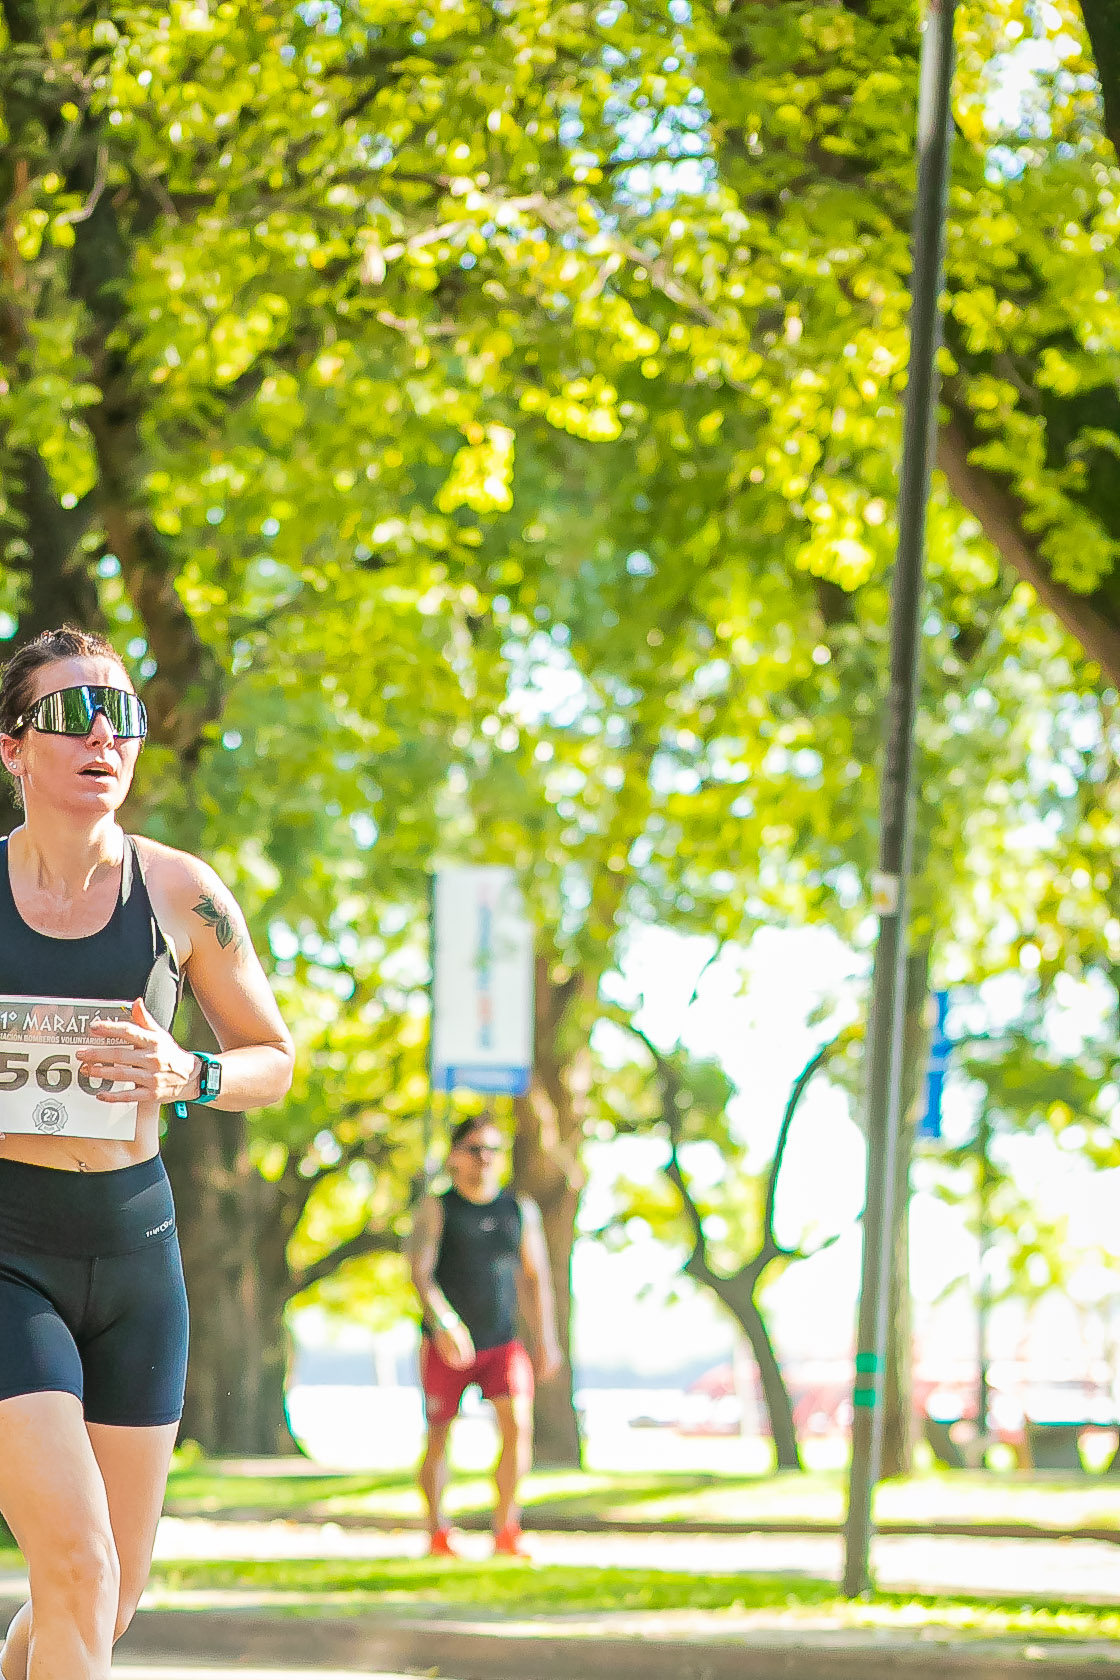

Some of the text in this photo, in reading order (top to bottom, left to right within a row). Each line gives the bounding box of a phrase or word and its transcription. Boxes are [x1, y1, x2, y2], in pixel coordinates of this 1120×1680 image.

[22, 1009, 119, 1034] MARATÓ
[23, 1033, 60, 1044] BOMBEROS
[60, 1035, 105, 1046] VOLUNTARIOS
